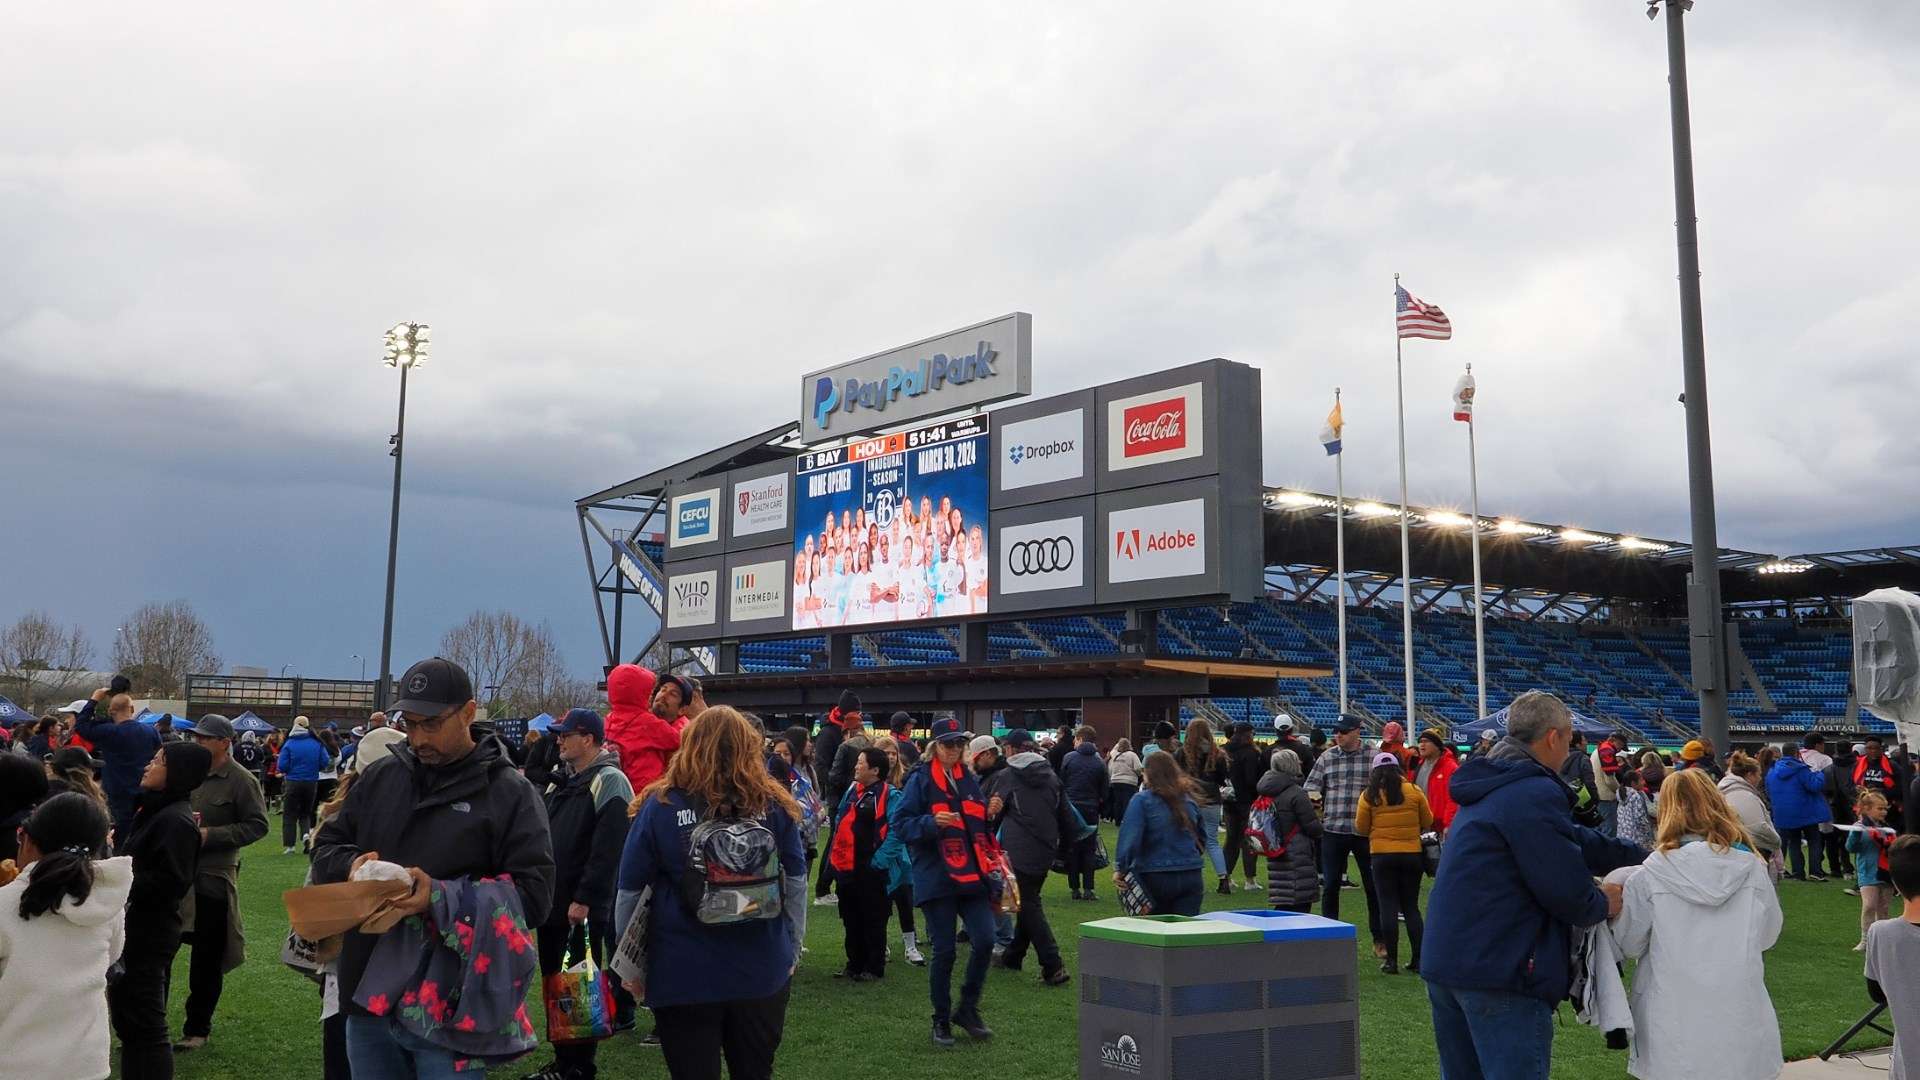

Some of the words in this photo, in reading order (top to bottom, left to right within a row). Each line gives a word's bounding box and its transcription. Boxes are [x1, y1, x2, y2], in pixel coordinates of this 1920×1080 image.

[844, 358, 931, 412] PayPal
[930, 340, 998, 390] Park
[957, 419, 975, 428] UNTIL
[1126, 410, 1183, 445] Coca-Cola
[909, 426, 946, 447] 51:41
[817, 449, 841, 467] BAY
[855, 439, 885, 459] HOU
[918, 447, 943, 475] MARCH
[944, 444, 957, 471] 30,
[957, 439, 976, 468] 2024
[1026, 440, 1075, 460] Dropbox
[867, 454, 904, 473] INAUGURAL
[809, 473, 827, 498] HOME
[827, 468, 851, 494] OPENER
[872, 469, 898, 486] SEASON
[751, 483, 783, 502] Stanford
[680, 505, 709, 523] CEFCU
[751, 501, 769, 512] HEALTH
[770, 500, 783, 509] CARE
[1147, 529, 1196, 551] Adobe
[620, 552, 643, 588] HOME
[640, 576, 654, 598] OF
[650, 586, 663, 615] TH
[736, 591, 779, 605] INTERMEDIA
[676, 808, 697, 827] 2024
[1101, 1046, 1120, 1062] SAN
[1119, 1049, 1141, 1067] JOSE
